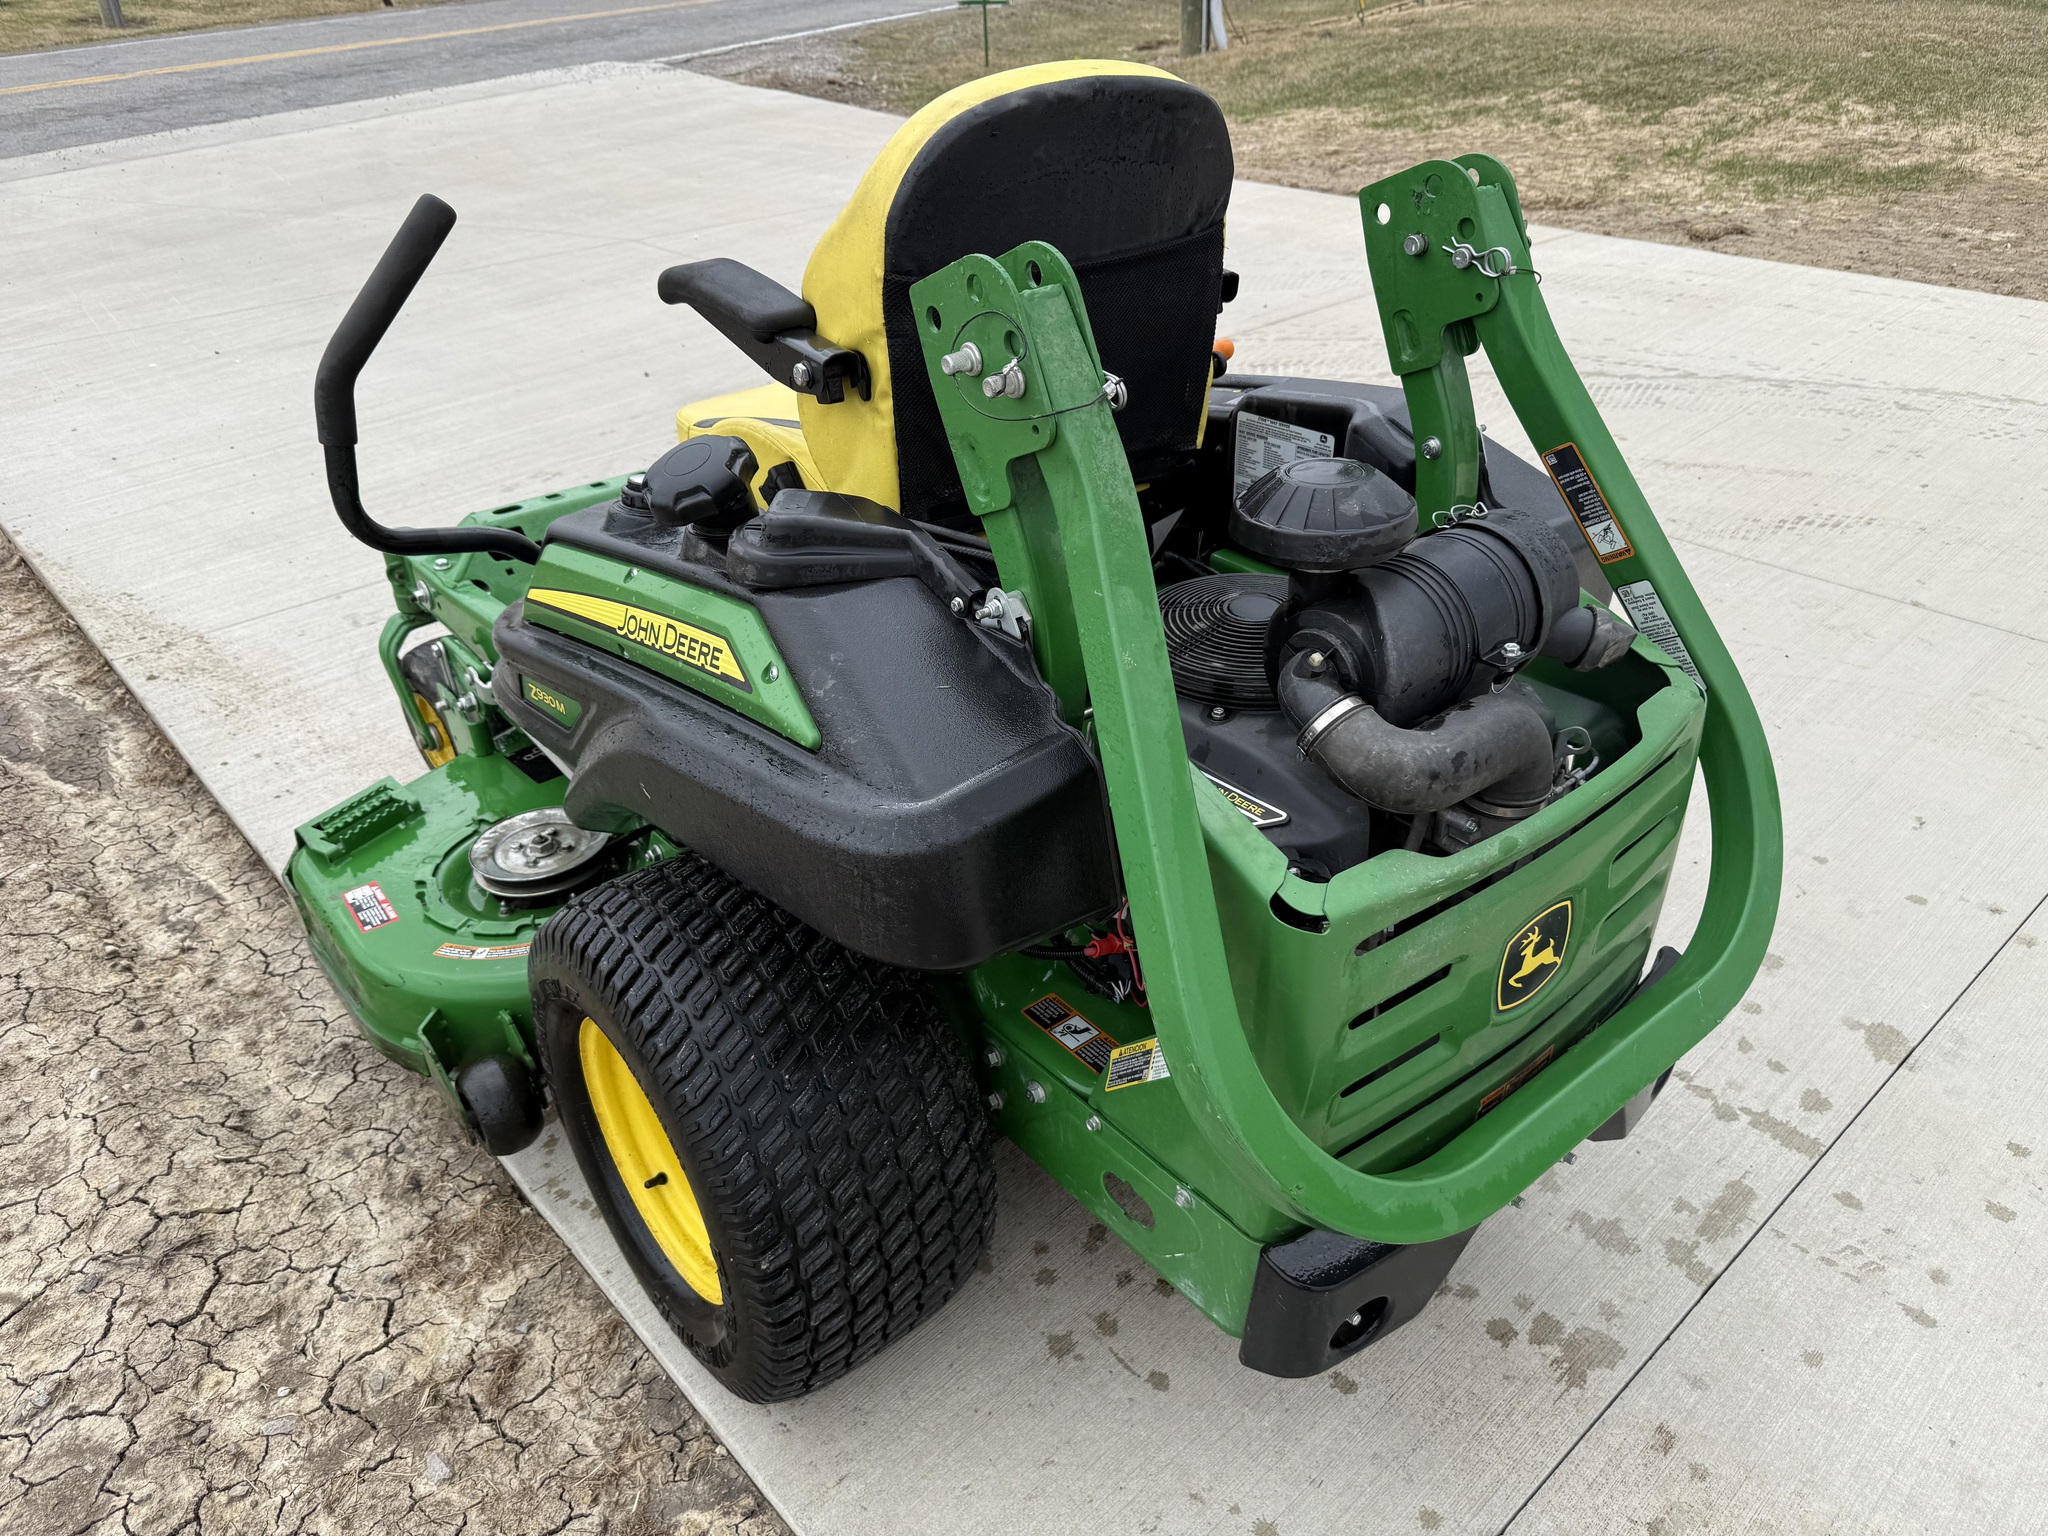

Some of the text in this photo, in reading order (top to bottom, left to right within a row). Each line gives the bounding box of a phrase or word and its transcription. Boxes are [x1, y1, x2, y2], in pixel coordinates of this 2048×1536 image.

[1600, 551, 1626, 562] WARNING
[617, 608, 724, 671] JOHN DEERE
[528, 683, 566, 715] Z930M
[1227, 792, 1265, 815] DEERE
